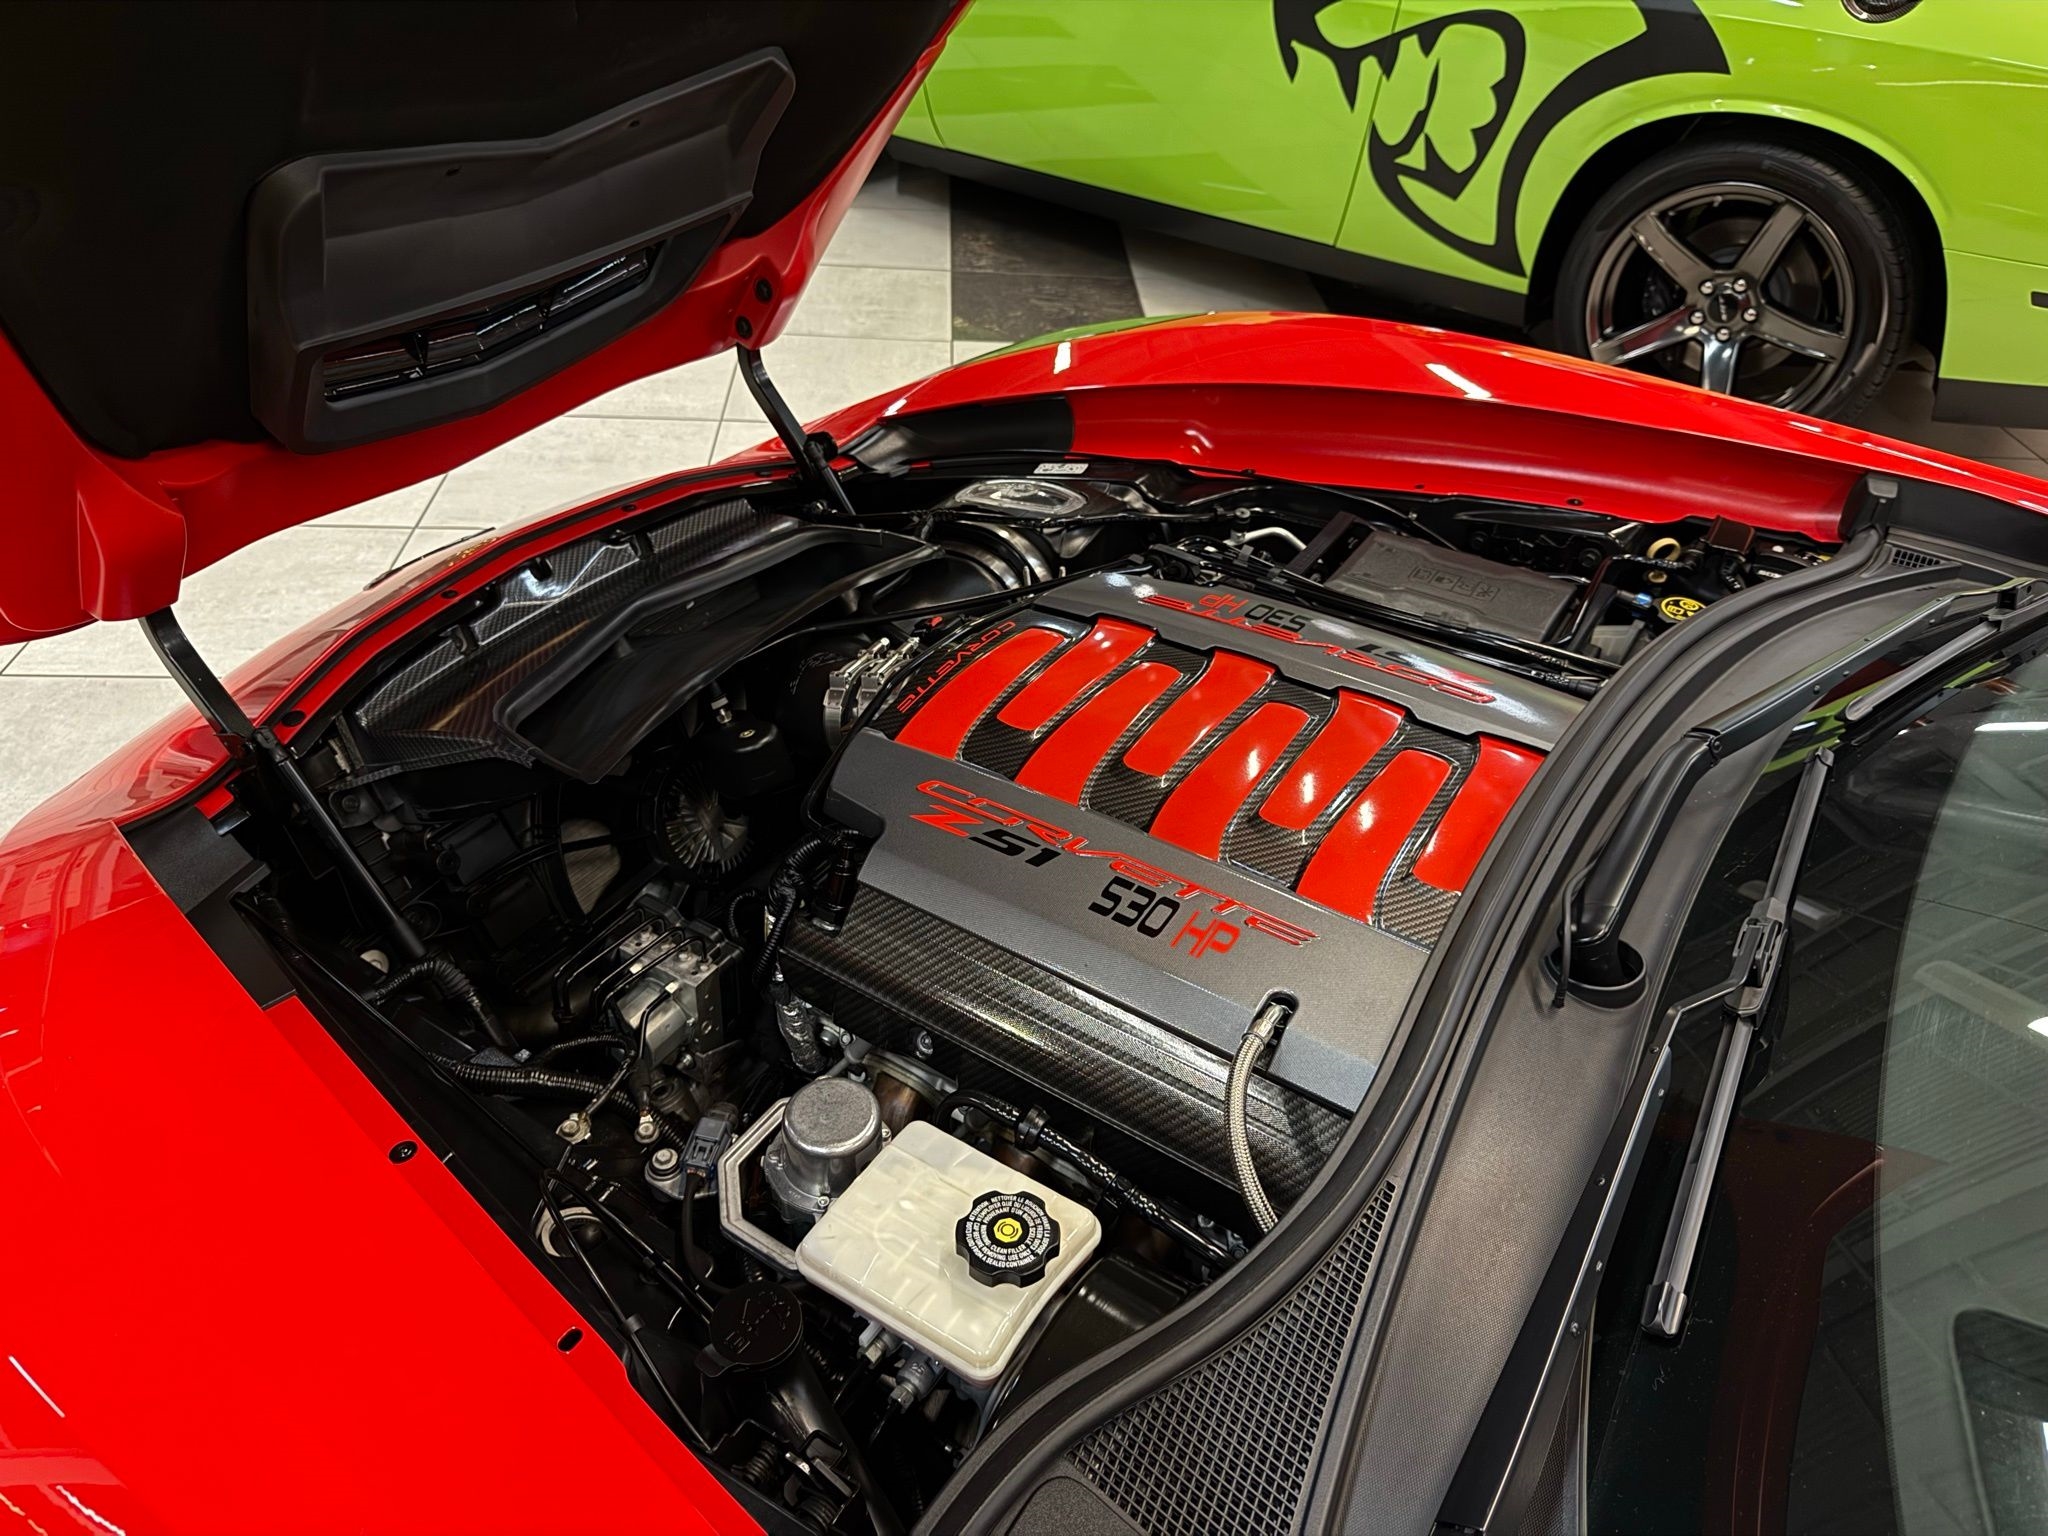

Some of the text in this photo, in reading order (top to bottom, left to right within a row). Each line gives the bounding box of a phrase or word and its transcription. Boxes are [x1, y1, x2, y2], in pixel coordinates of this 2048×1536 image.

[1200, 593, 1309, 633] 530 HP
[897, 620, 1016, 713] CORVETTE
[1139, 594, 1497, 704] CORVETTE
[909, 804, 1062, 868] Z51
[916, 779, 1321, 947] CORVETTE
[1088, 876, 1241, 960] 530 HP
[971, 1246, 984, 1259] FROM
[986, 1257, 1006, 1268] SEALED
[990, 1244, 1007, 1254] CLEAN
[1008, 1243, 1026, 1254] FILLER
[1018, 1248, 1031, 1259] ONLY
